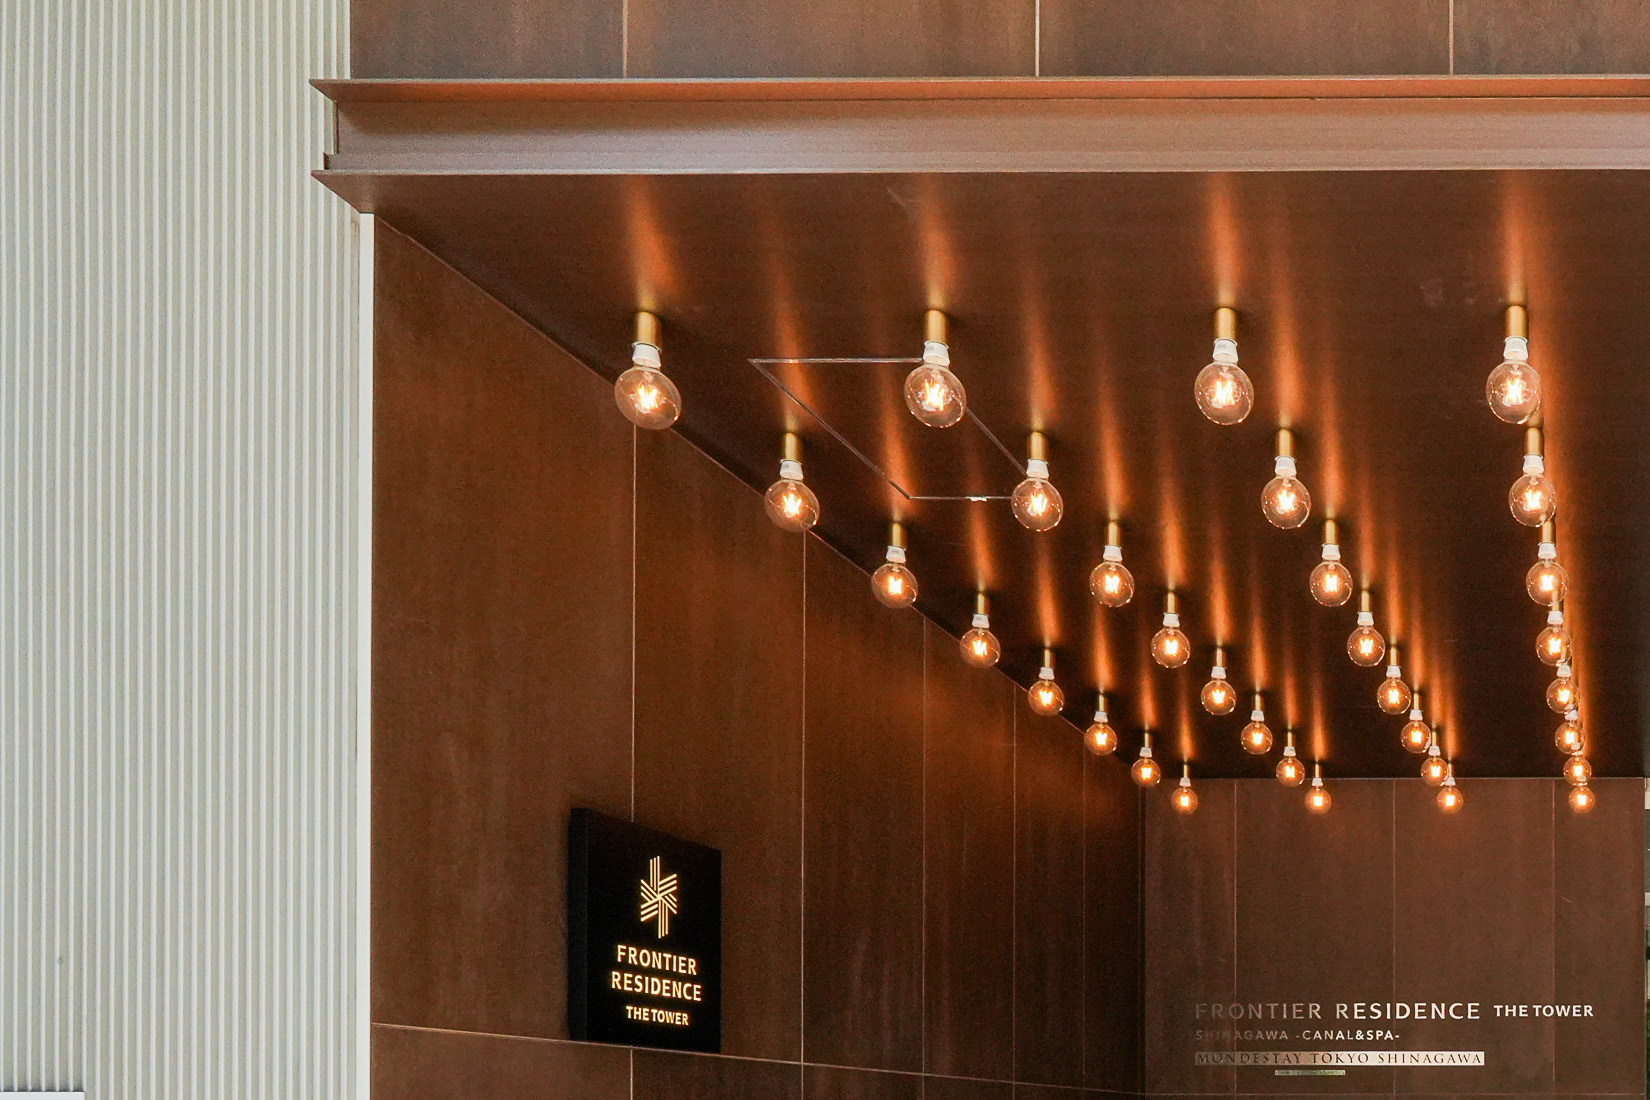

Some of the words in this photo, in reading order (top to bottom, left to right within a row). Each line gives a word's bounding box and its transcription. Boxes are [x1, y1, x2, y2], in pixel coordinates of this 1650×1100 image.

[617, 944, 697, 976] FRONTIER
[611, 971, 702, 1002] RESIDENCE
[626, 1006, 650, 1021] THE
[650, 1008, 689, 1026] TOWER
[1195, 1003, 1322, 1019] FRONTIER
[1336, 1003, 1480, 1019] RESIDENCE
[1493, 1005, 1528, 1017] THE
[1532, 1005, 1594, 1017] TOWER
[1195, 1030, 1289, 1040] SAGAWA
[1198, 1052, 1302, 1064] MONDESTAY
[1310, 1052, 1369, 1064] TOKYO
[1378, 1053, 1482, 1064] SHINAGAWA
